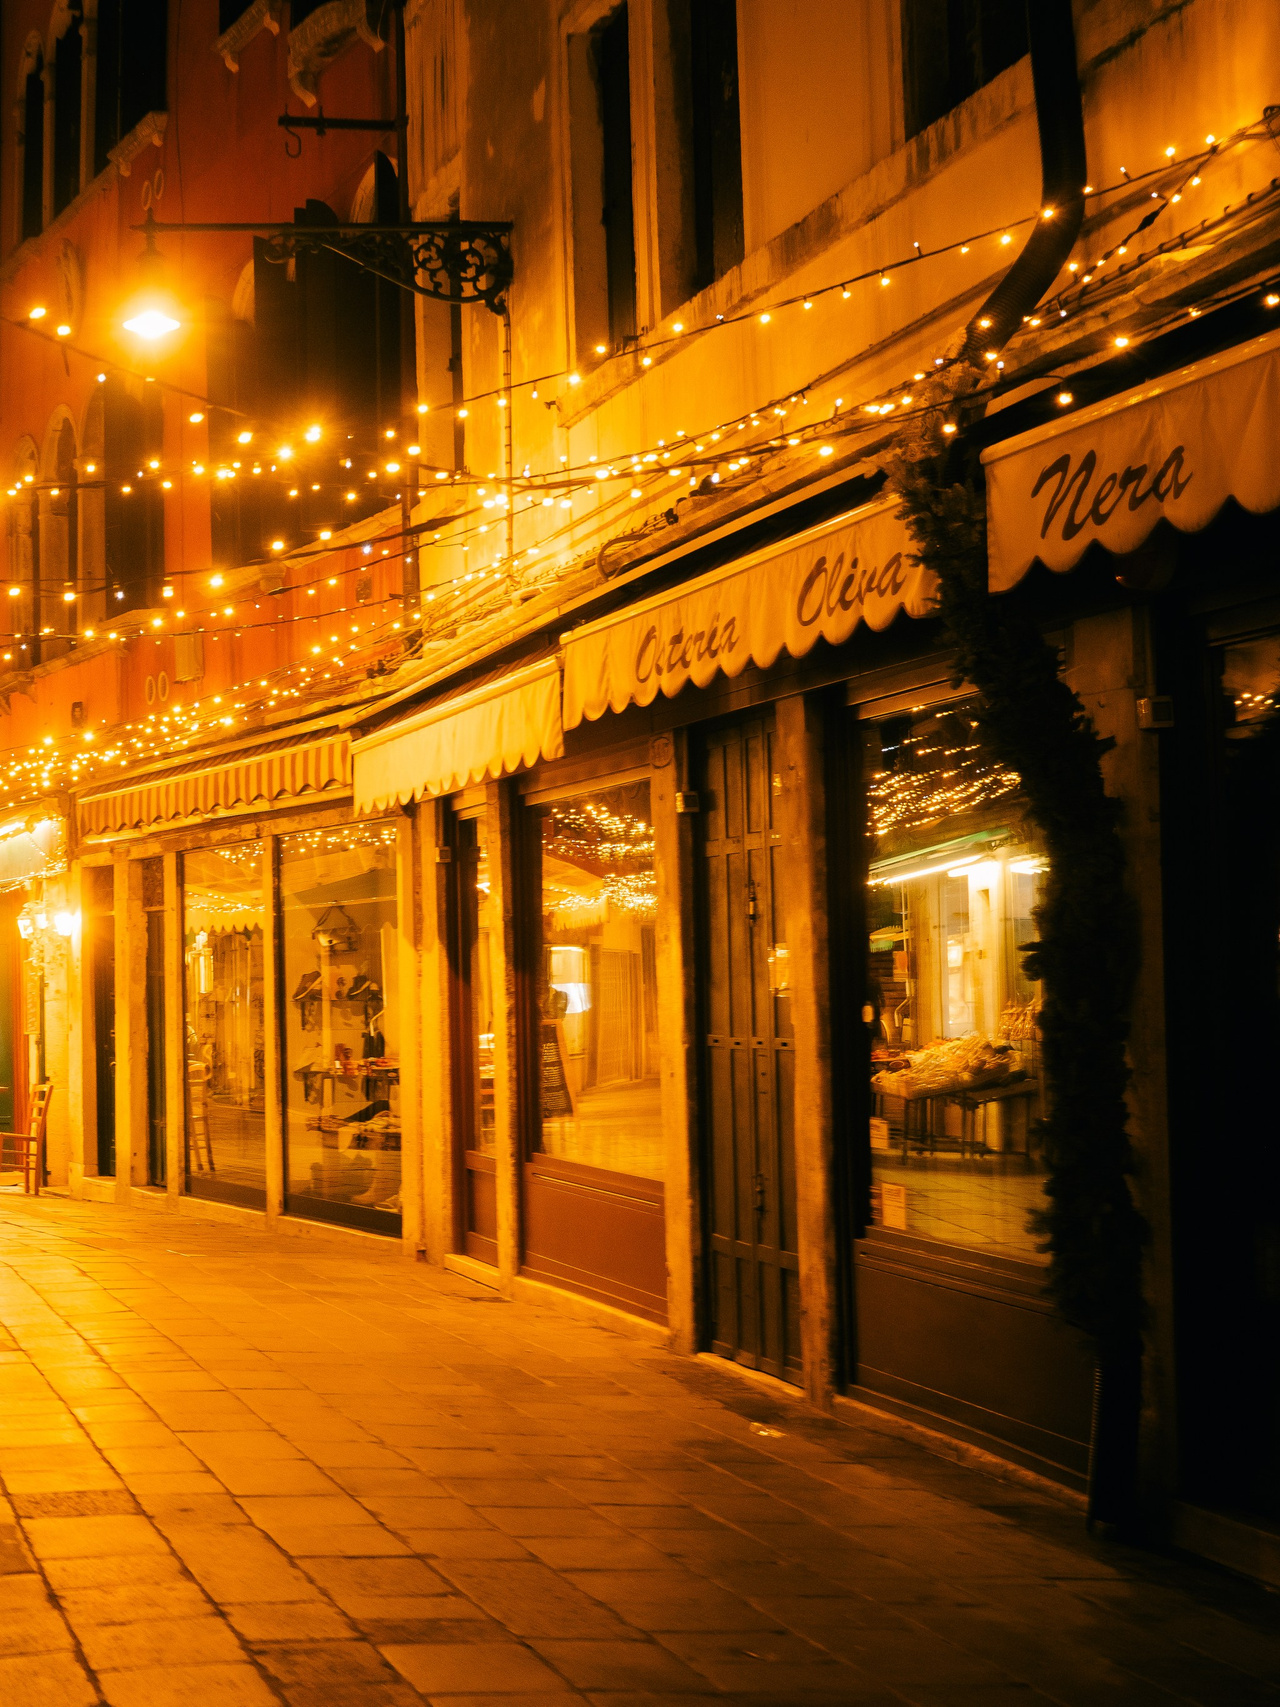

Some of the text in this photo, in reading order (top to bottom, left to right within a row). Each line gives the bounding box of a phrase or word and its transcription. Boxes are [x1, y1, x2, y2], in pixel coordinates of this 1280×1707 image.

[1030, 445, 1194, 541] Nera
[635, 551, 909, 684] Osteria Oliva
